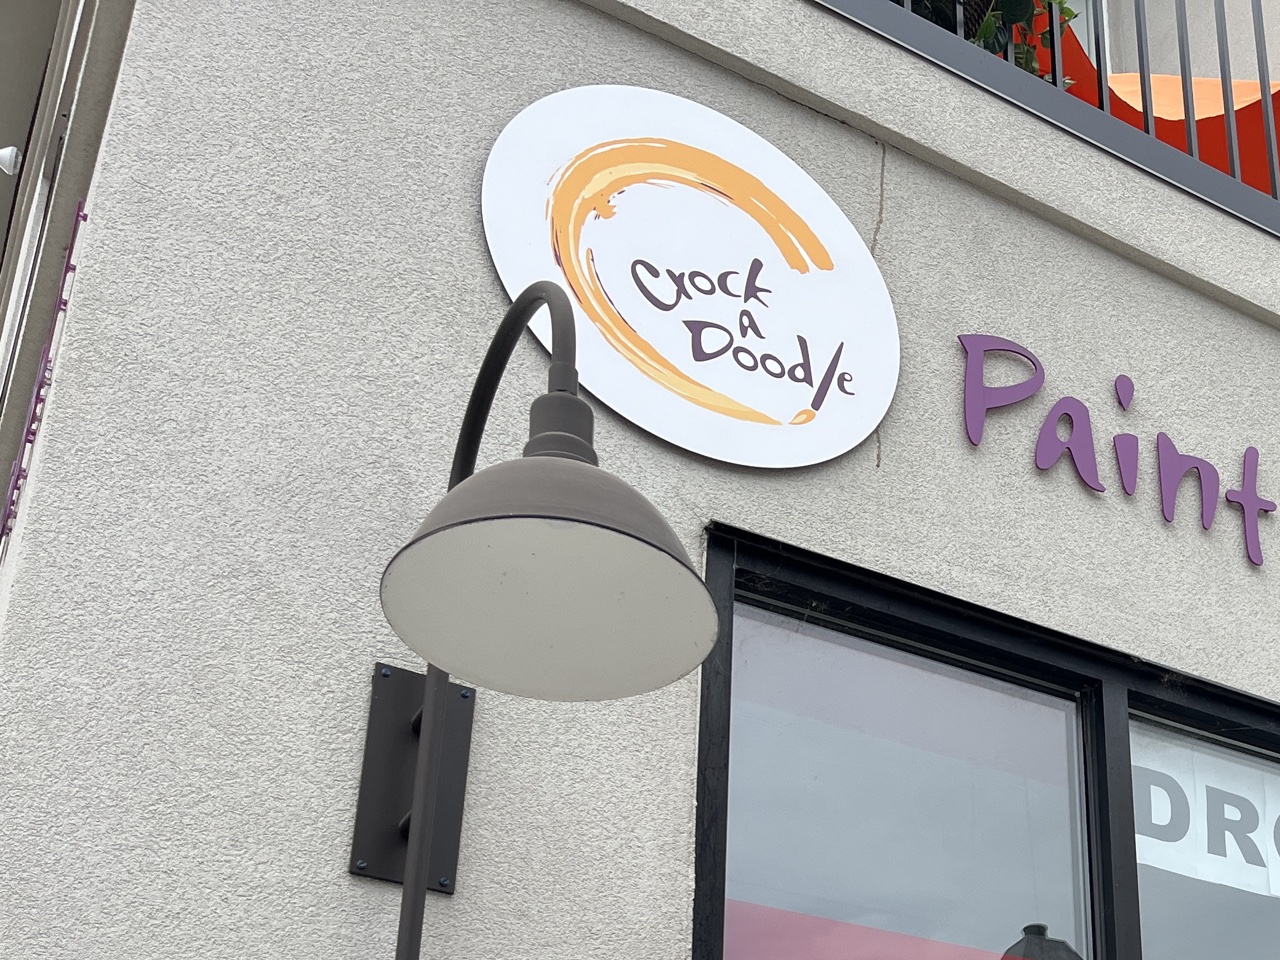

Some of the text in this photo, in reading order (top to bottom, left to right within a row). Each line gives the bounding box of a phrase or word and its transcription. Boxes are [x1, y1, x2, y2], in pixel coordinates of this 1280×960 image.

[630, 257, 773, 312] Crock
[681, 319, 855, 416] Doodle
[957, 333, 1278, 567] Paint
